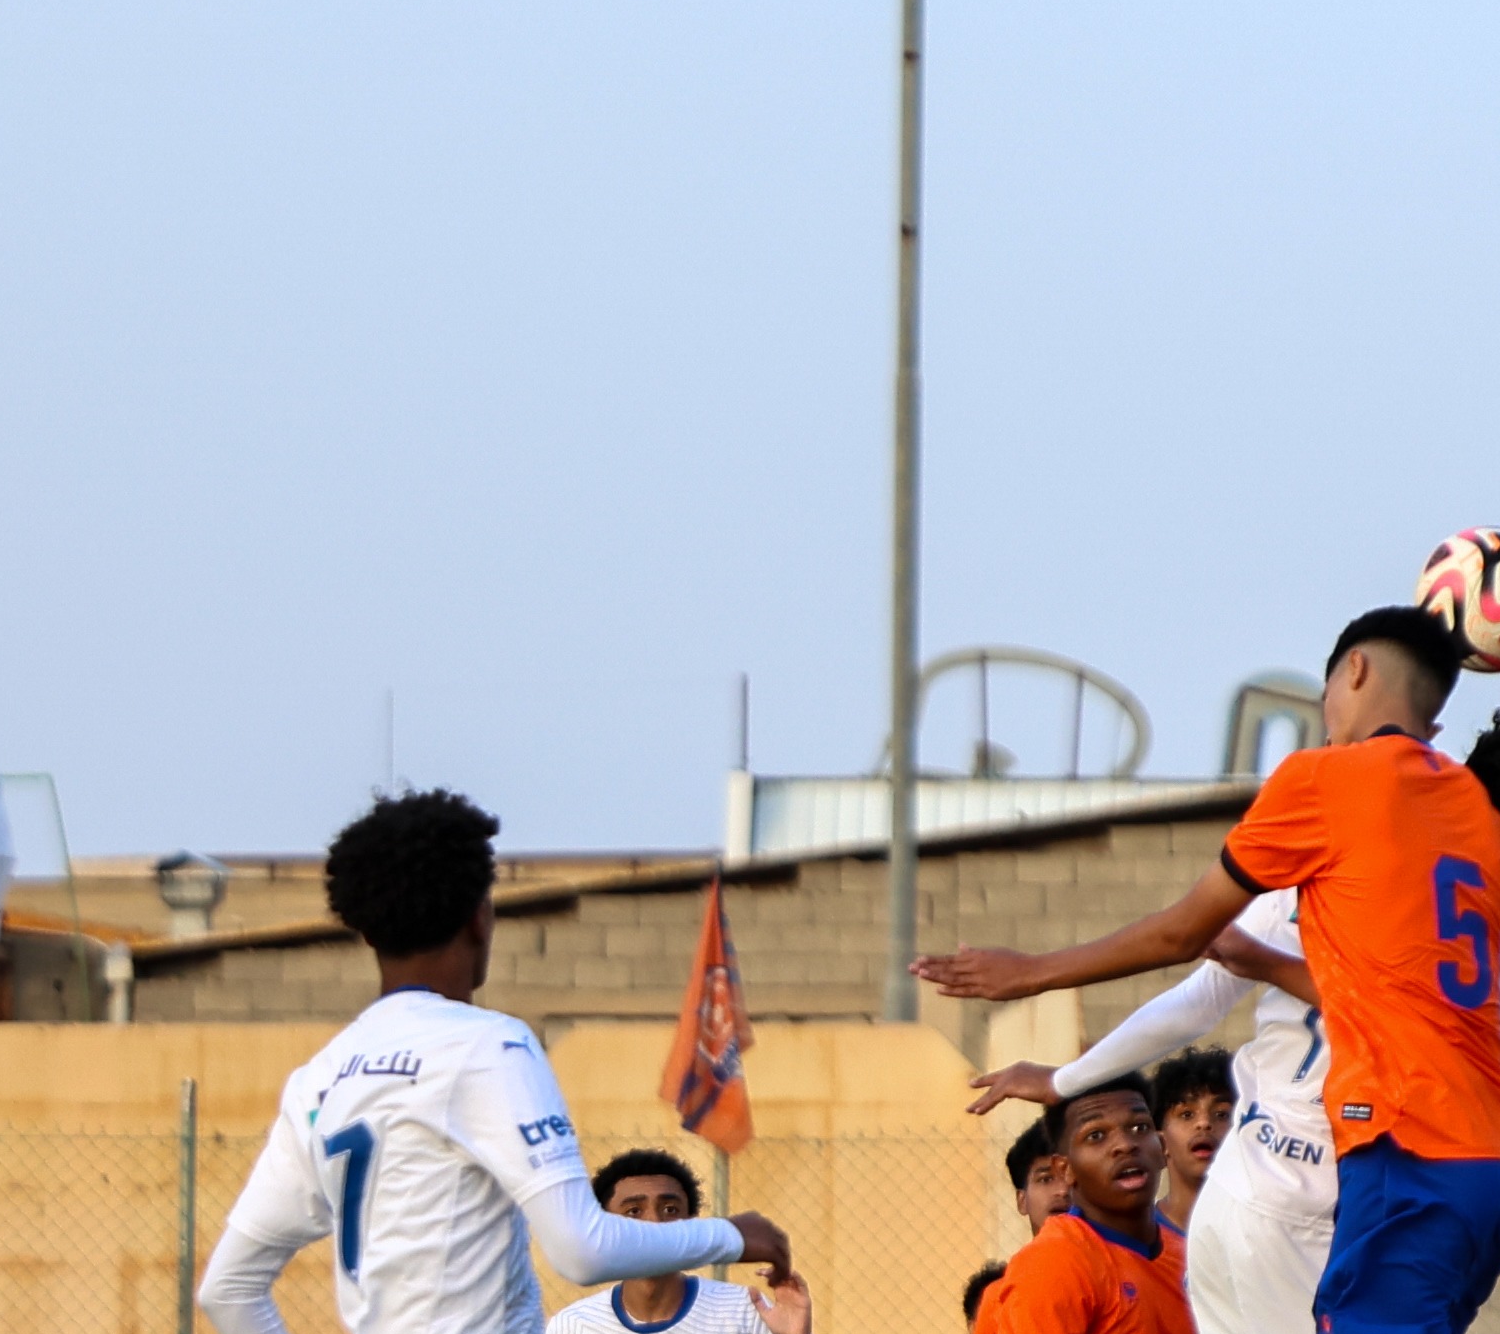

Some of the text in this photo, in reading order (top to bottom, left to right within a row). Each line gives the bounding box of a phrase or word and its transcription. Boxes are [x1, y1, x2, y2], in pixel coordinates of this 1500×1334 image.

[1433, 853, 1492, 1010] 5
[332, 1049, 422, 1087] بنك الر
[323, 1118, 377, 1285] 7
